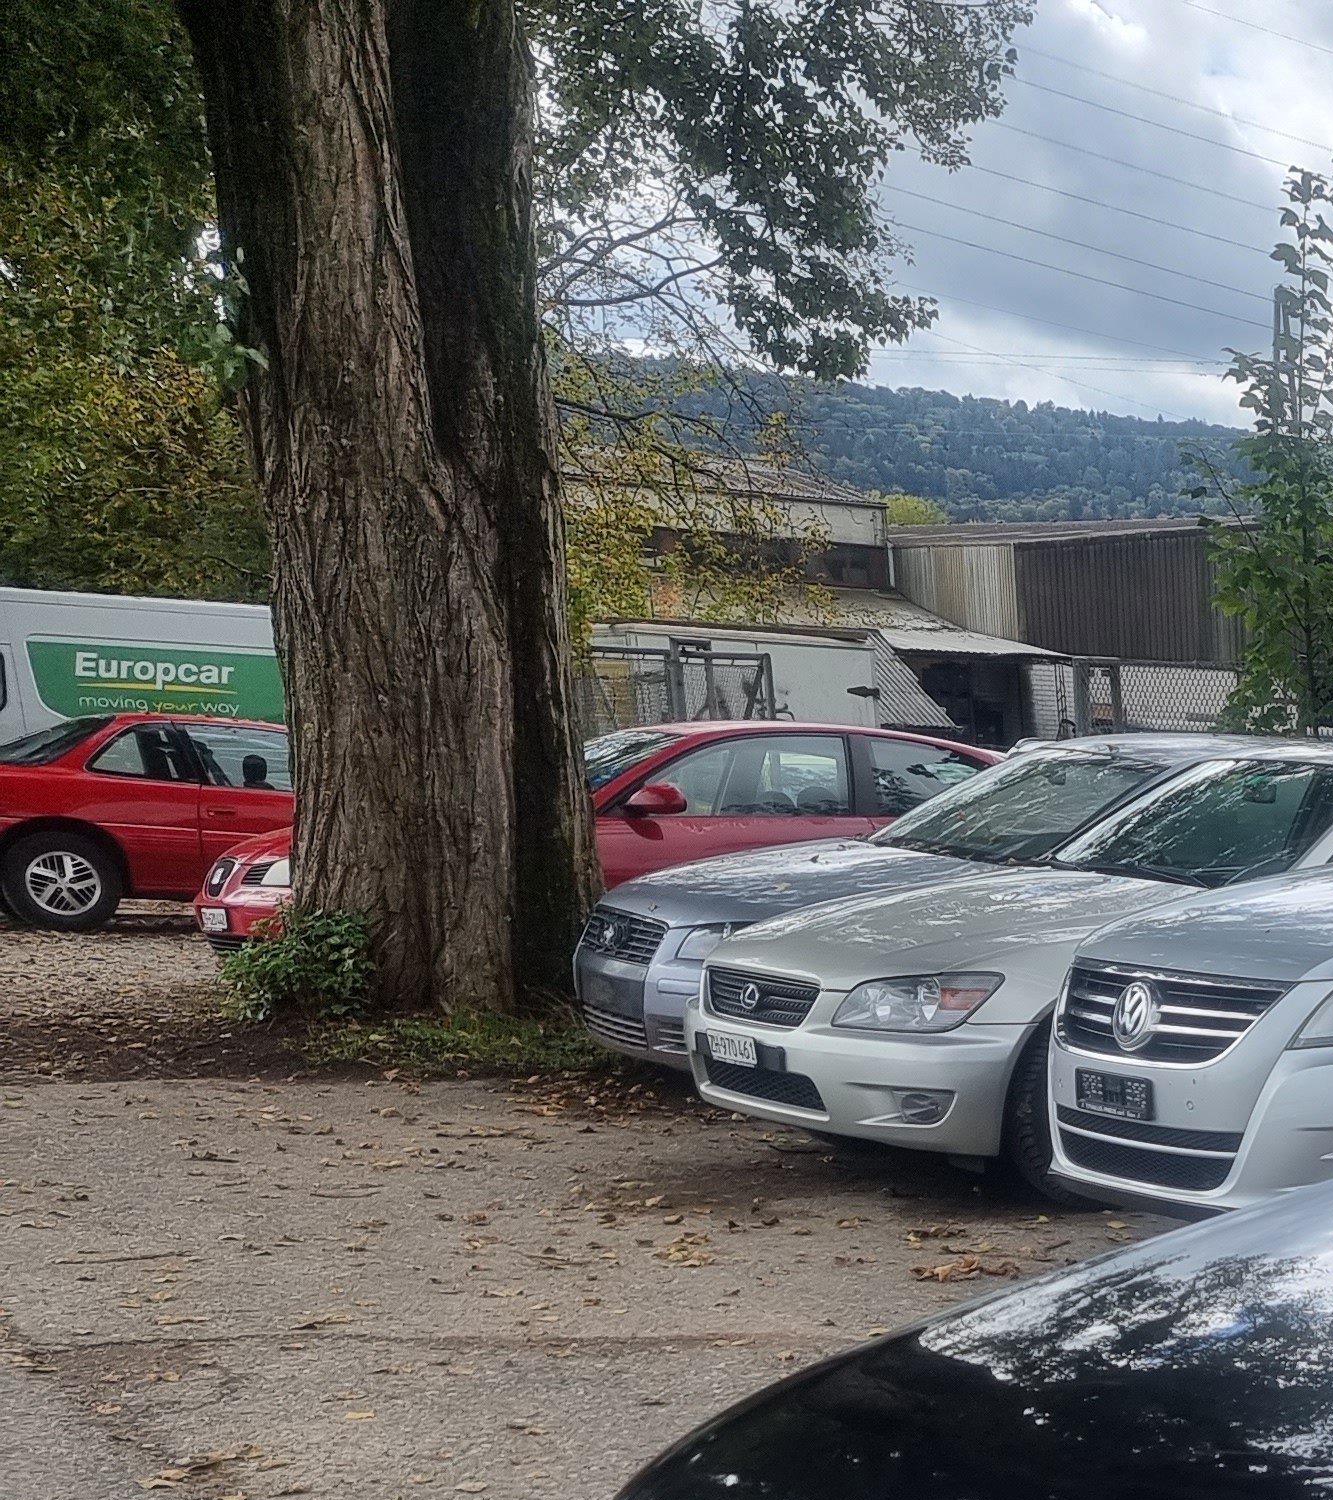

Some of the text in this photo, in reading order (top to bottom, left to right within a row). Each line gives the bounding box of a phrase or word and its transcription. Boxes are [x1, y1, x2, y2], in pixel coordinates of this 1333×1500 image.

[75, 651, 235, 690] Europcar
[79, 695, 239, 717] moving your way
